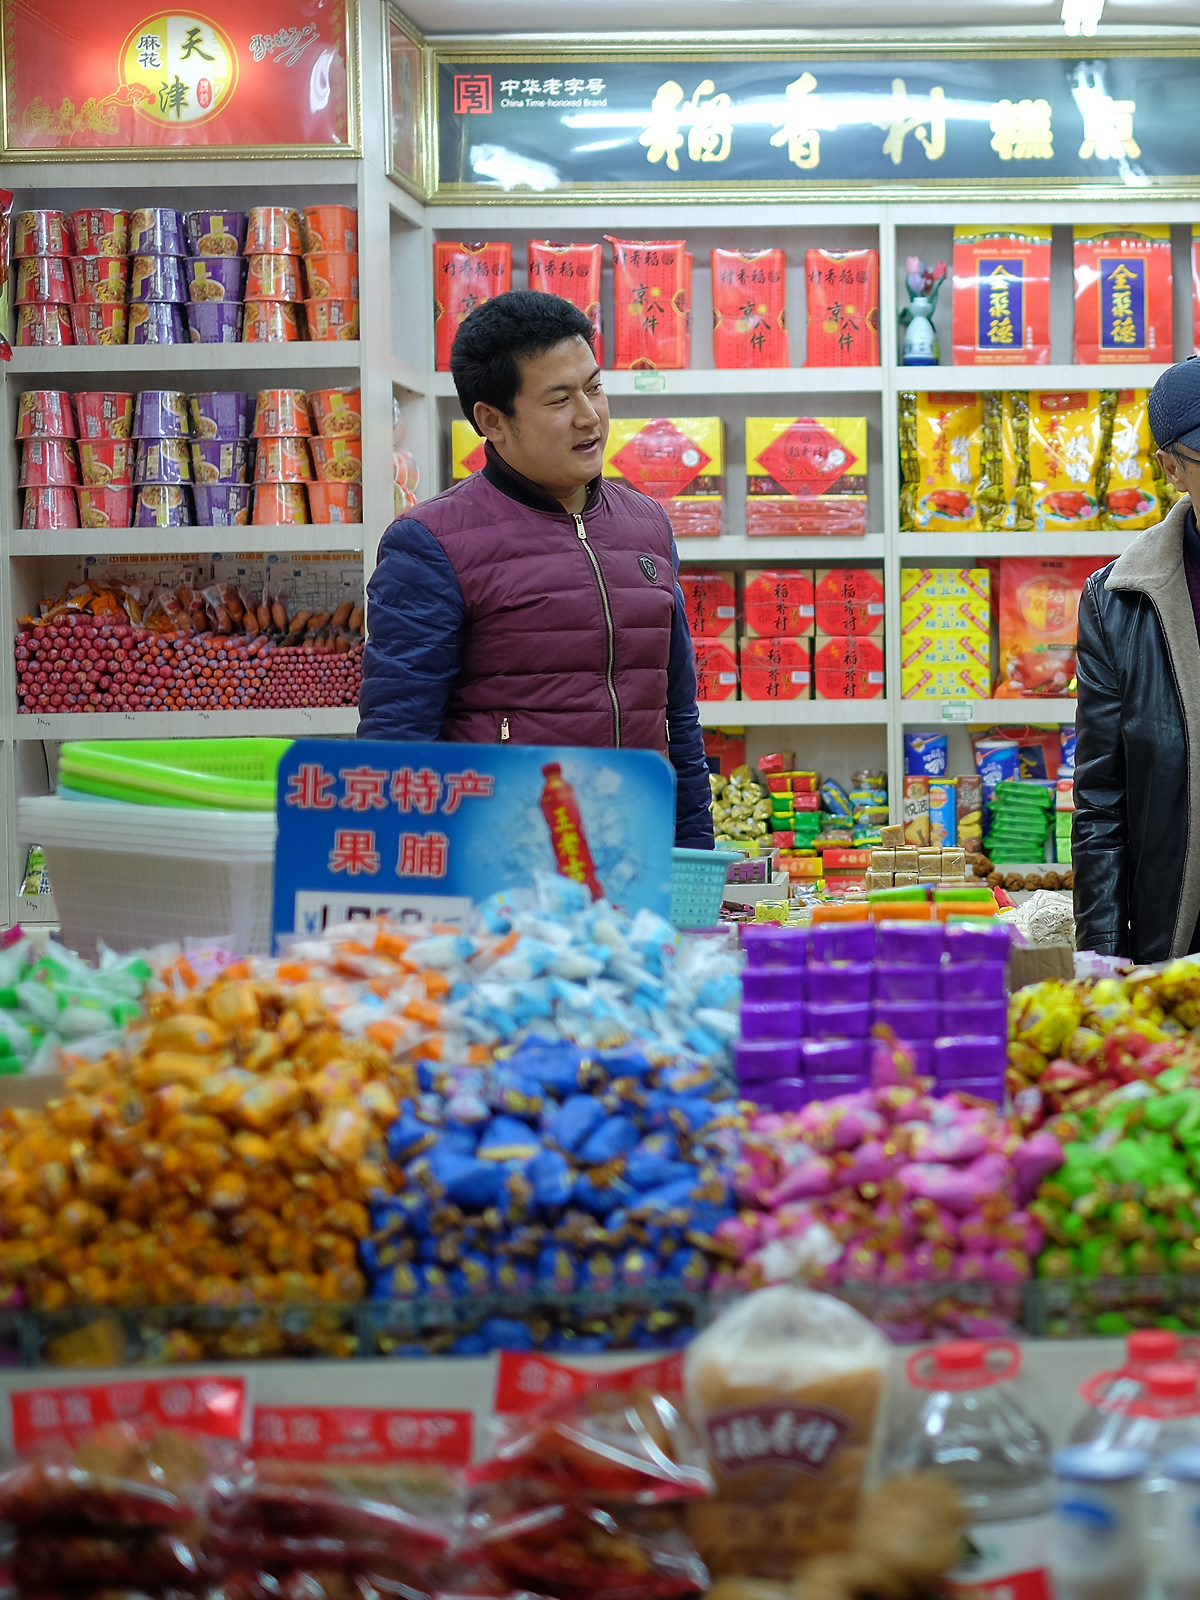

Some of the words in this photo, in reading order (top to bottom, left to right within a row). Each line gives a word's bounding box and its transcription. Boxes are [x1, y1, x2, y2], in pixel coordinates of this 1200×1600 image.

[138, 35, 162, 68] 麻花
[159, 28, 215, 118] 天津
[500, 78, 606, 96] 中华老字号
[500, 98, 524, 108] China
[526, 98, 582, 107] Time-honored
[583, 98, 607, 107] Brand
[632, 283, 665, 336] 京八件
[739, 300, 771, 353] 京八件
[827, 301, 859, 353] 京八件
[287, 763, 494, 814] 北京特产
[330, 829, 449, 878] 果脯
